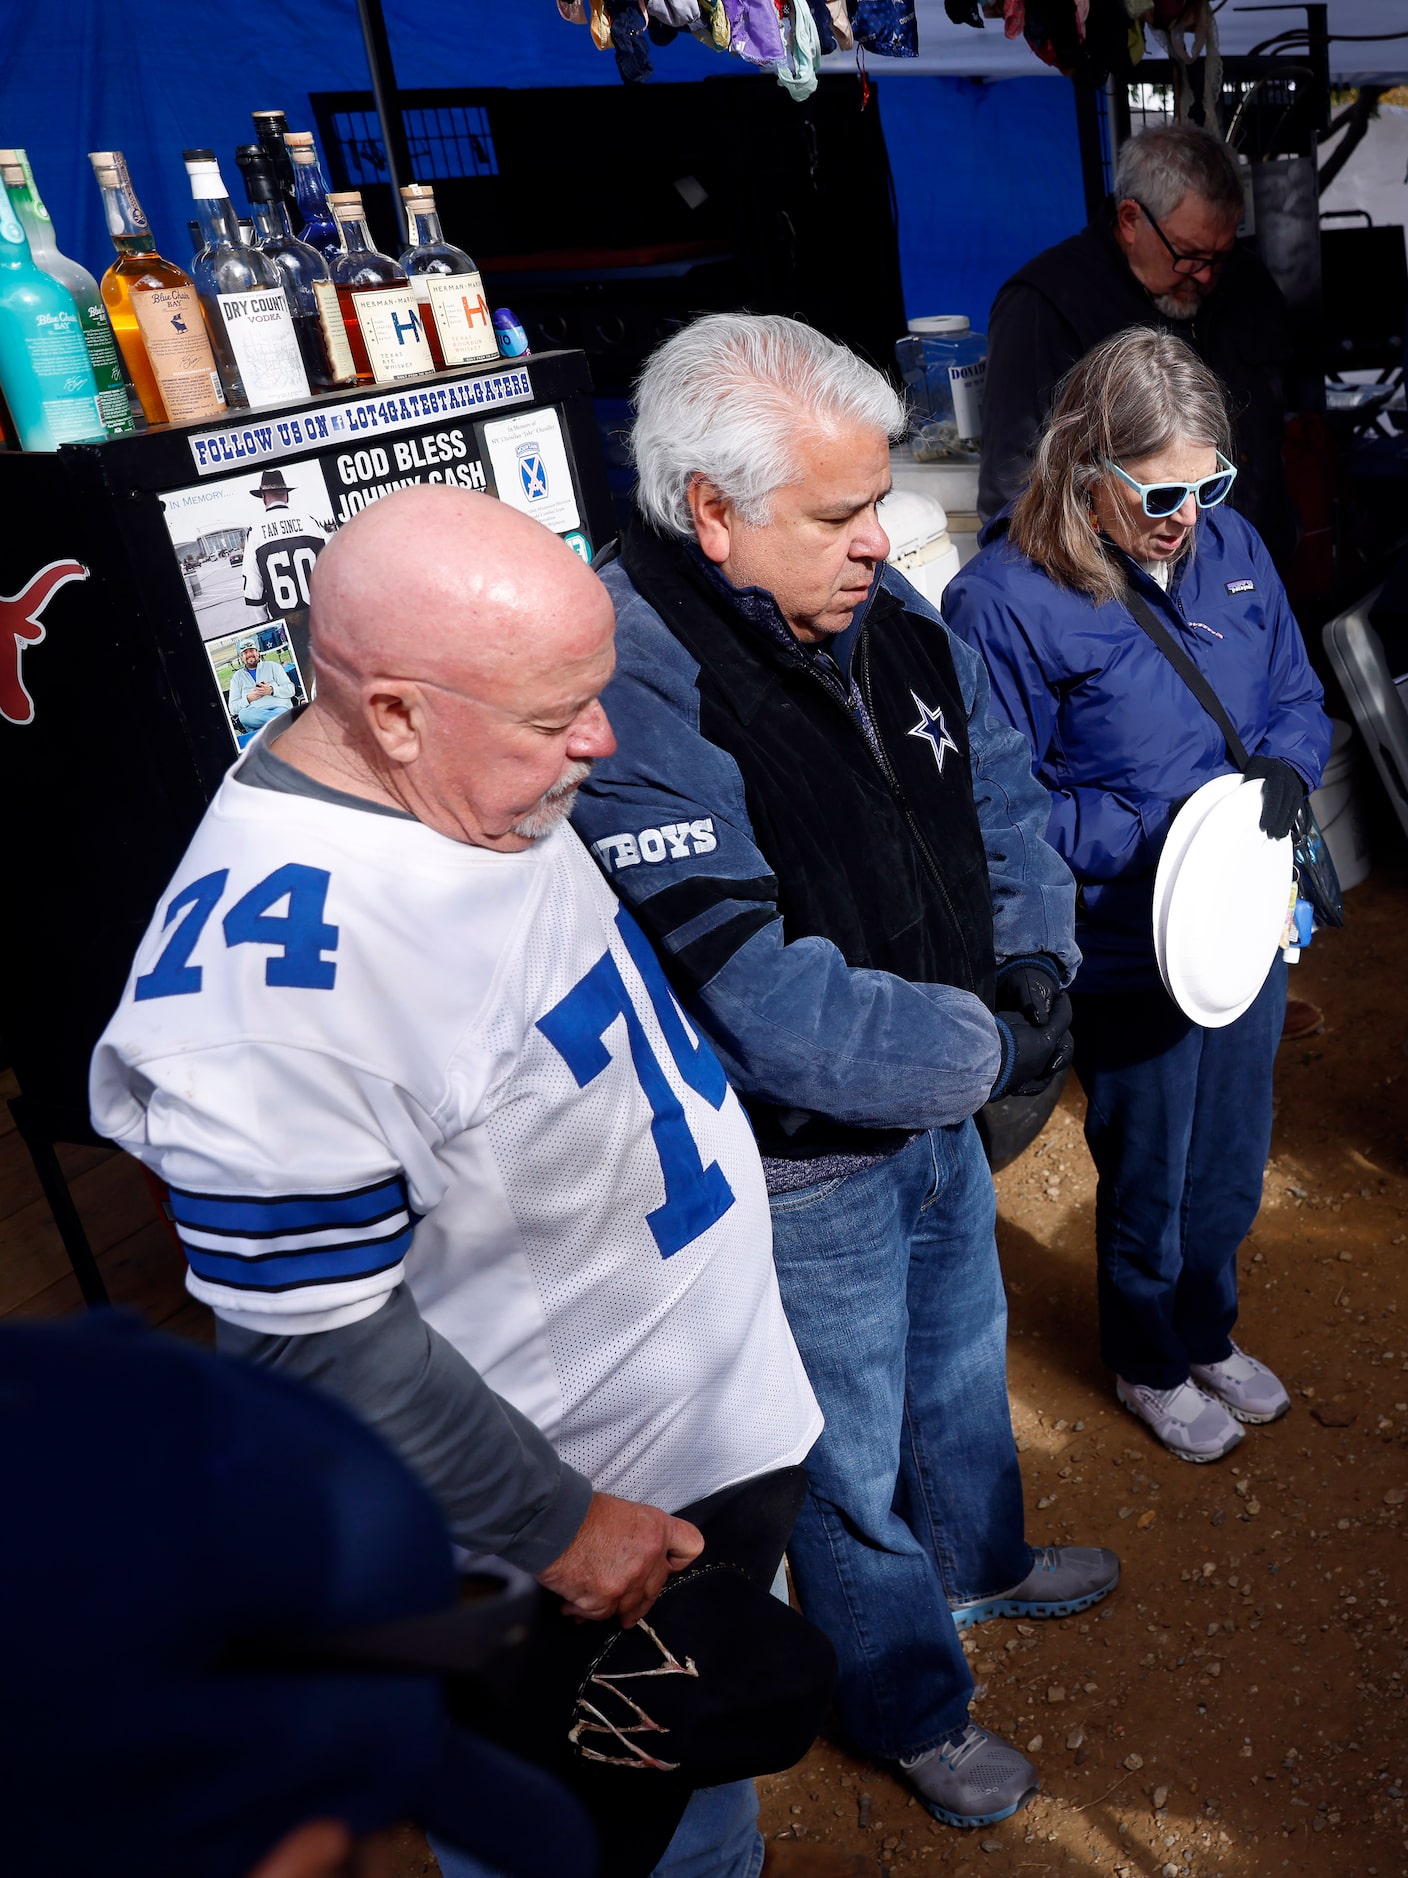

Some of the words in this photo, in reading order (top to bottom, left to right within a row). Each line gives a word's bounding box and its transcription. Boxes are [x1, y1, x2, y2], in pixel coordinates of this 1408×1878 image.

[433, 284, 465, 293] HERMAN
[151, 293, 171, 304] Blue
[171, 290, 190, 301] Chair
[360, 299, 394, 308] HERMAN
[223, 299, 249, 320] DRY
[247, 313, 282, 323] VODKA
[54, 321, 70, 330] BAY
[453, 340, 483, 348] BOURBON
[194, 426, 273, 465] FOLLOW
[277, 421, 304, 446] US
[305, 414, 330, 440] ON
[337, 447, 390, 485] GOD
[393, 430, 467, 472] BLESS
[169, 501, 180, 509] IN
[262, 529, 279, 539] FAN
[280, 519, 303, 535] SINCE
[266, 548, 317, 610] 60
[134, 863, 339, 1002] 74
